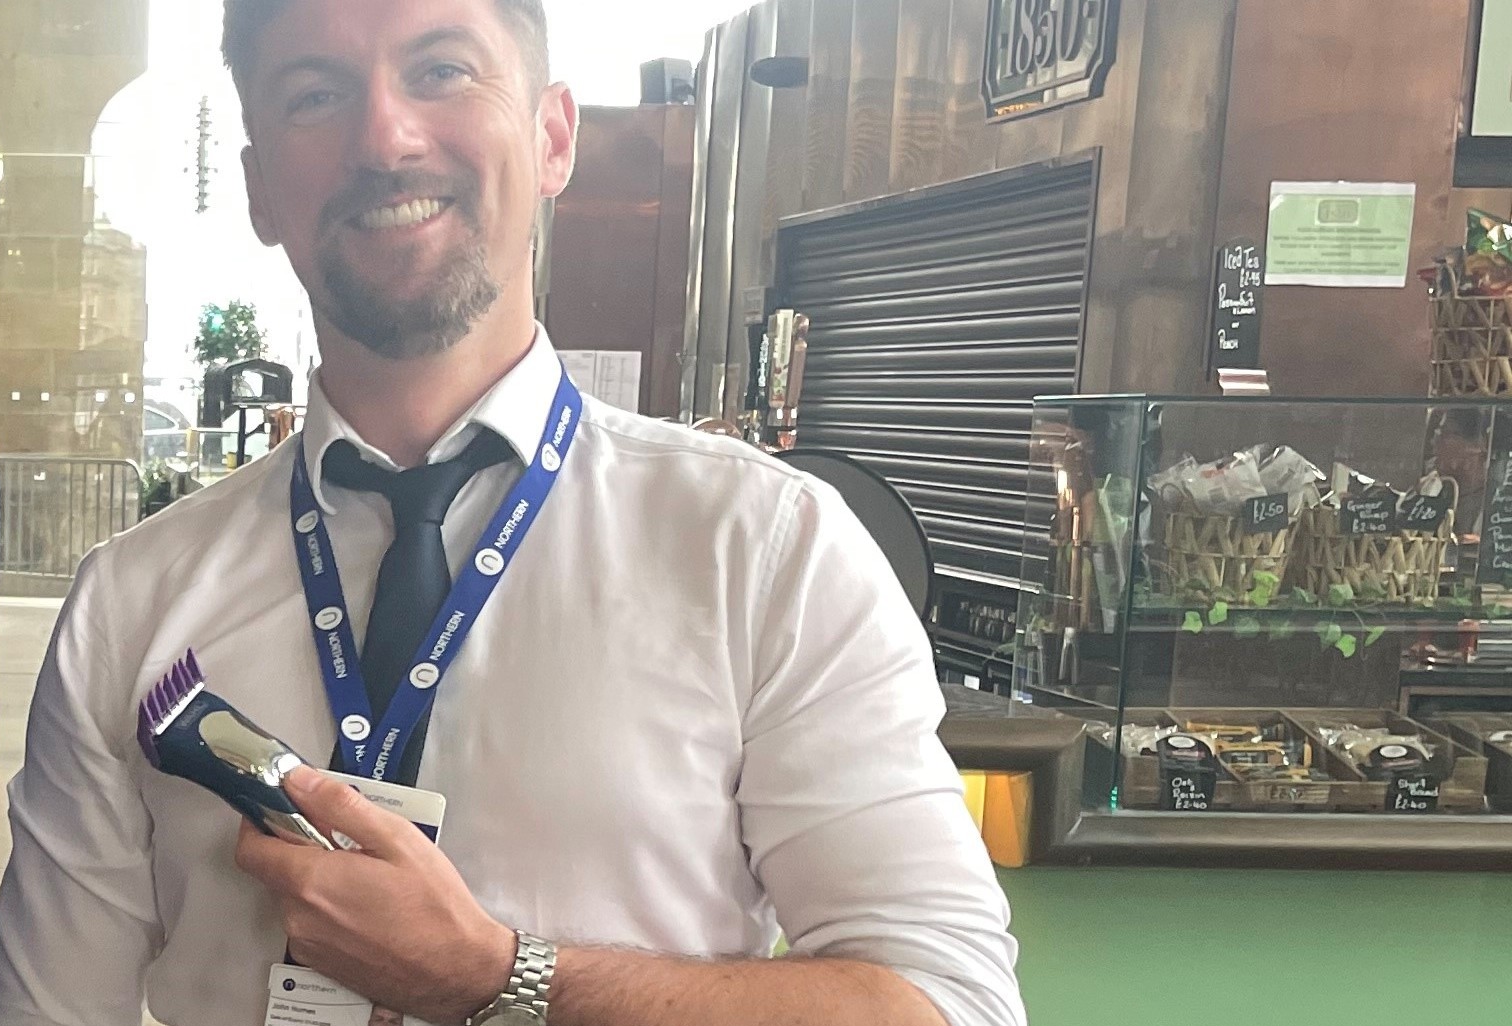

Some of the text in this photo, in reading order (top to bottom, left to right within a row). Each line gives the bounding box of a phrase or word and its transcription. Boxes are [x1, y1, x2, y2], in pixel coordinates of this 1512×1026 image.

[554, 405, 574, 447] NORTHERN
[496, 499, 529, 549] NORTHERN
[327, 631, 348, 680] NORTHERN
[429, 610, 465, 661] NORTHERN
